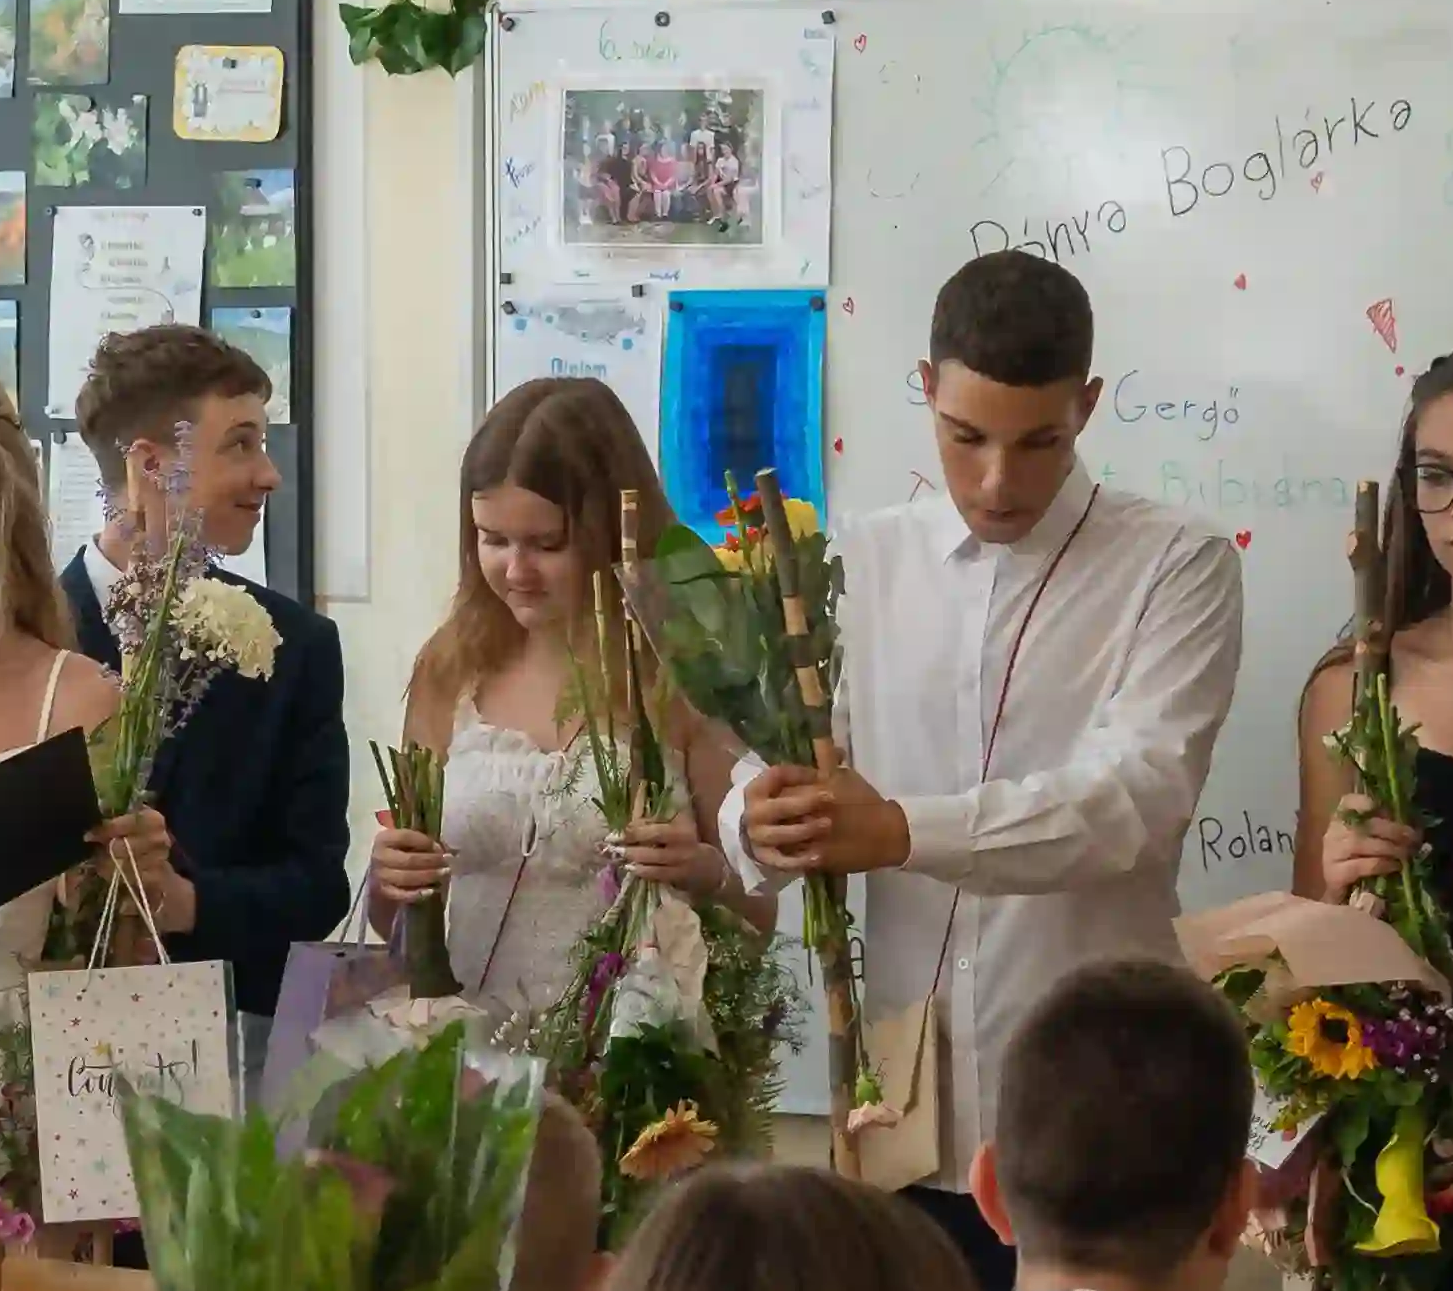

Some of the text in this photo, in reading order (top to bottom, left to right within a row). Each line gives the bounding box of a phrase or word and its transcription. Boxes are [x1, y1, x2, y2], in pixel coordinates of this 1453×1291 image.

[1160, 96, 1412, 217] Boglárka
[1114, 369, 1240, 441] Gergő
[1198, 809, 1295, 873] Rolan
